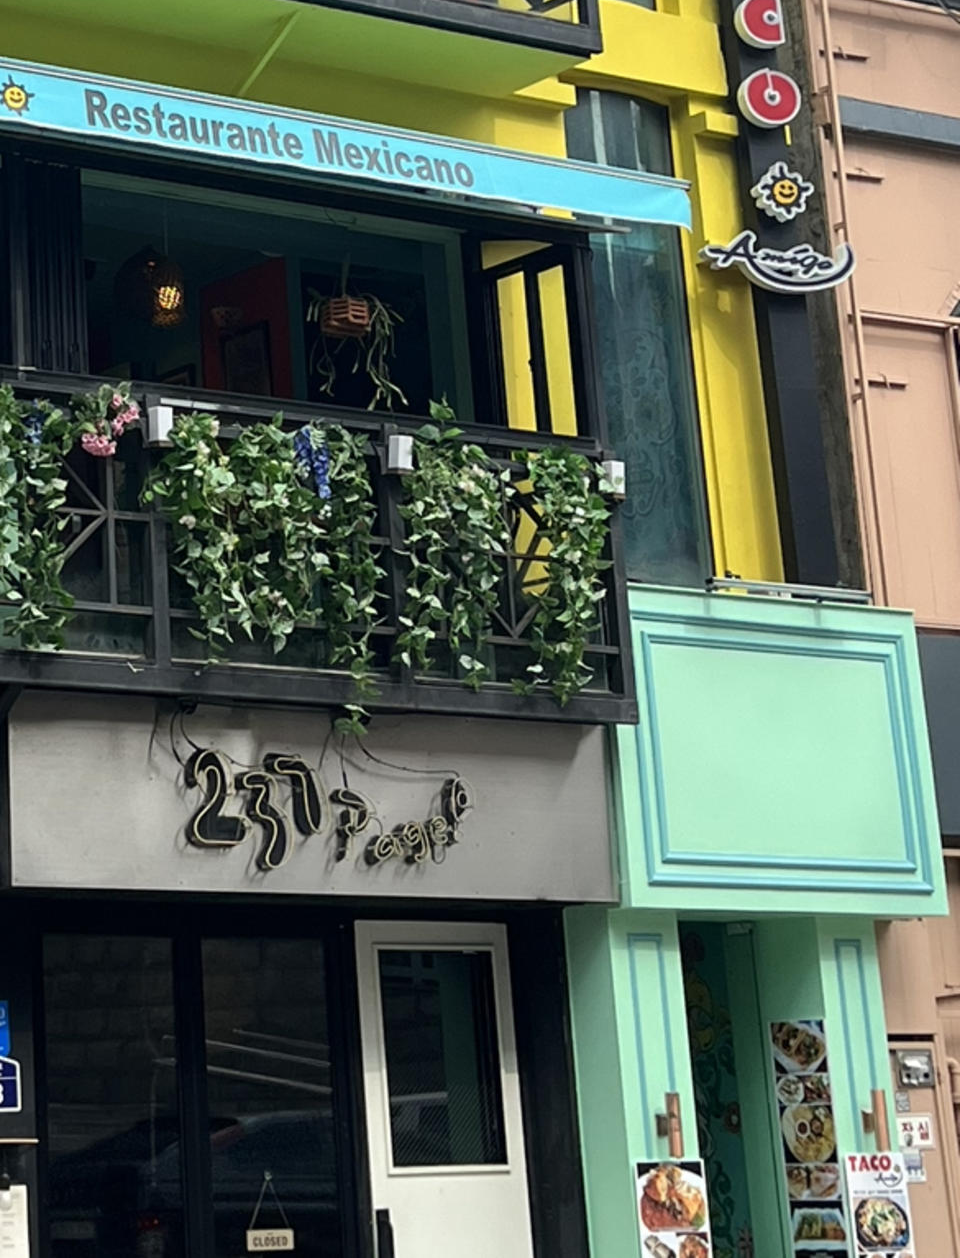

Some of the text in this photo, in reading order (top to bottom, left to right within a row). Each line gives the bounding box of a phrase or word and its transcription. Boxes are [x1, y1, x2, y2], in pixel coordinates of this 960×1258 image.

[84, 88, 304, 160] Restaurante
[312, 128, 475, 188] Mexicano
[848, 1154, 892, 1172] TACO
[252, 1236, 289, 1247] CLOSED
